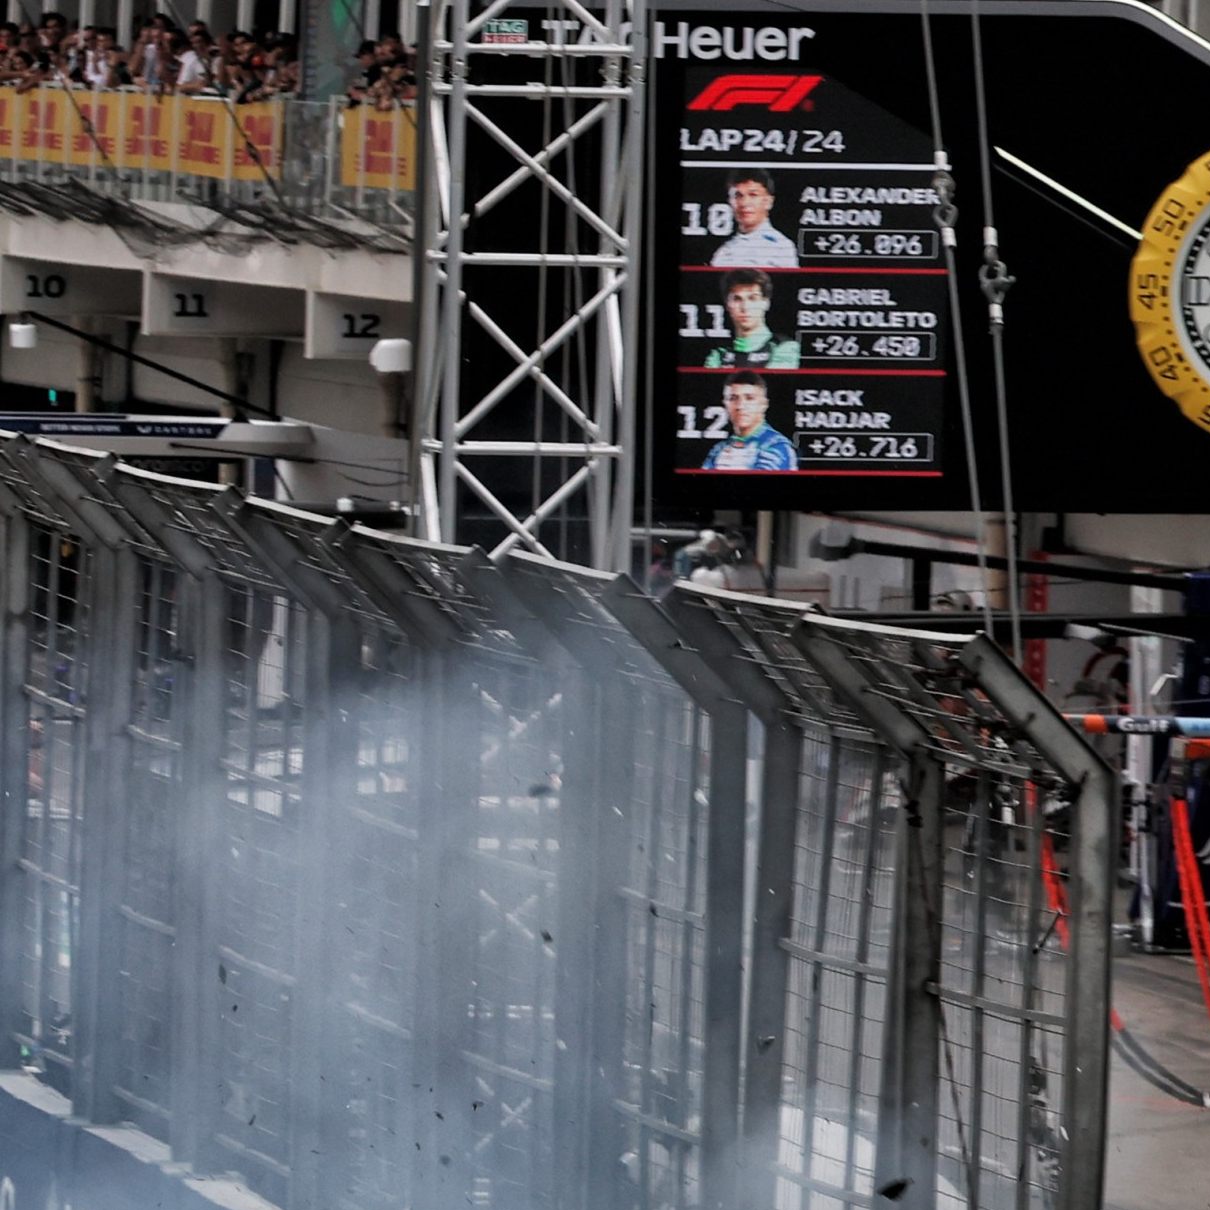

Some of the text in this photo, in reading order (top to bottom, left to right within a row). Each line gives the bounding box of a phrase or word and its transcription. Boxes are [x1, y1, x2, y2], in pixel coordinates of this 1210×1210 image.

[487, 20, 527, 33] TAG
[654, 21, 816, 60] Heuer
[800, 186, 941, 205] ALEXANDER
[681, 203, 734, 236] 10
[800, 208, 882, 226] ALBON
[1154, 199, 1186, 234] 50
[814, 234, 923, 255] +26.096
[26, 274, 66, 299] 10
[798, 288, 898, 306] GABRIEL
[1137, 273, 1159, 310] 45
[173, 294, 209, 318] 11
[342, 314, 380, 339] 12
[679, 304, 731, 338] 11
[797, 310, 937, 328] BORTOLETO
[1150, 349, 1179, 381] 40
[795, 389, 864, 406] ISACK
[677, 406, 729, 439] 12
[795, 411, 891, 429] HADJAR
[809, 437, 918, 458] +26.716
[1117, 717, 1169, 734] Gulf
